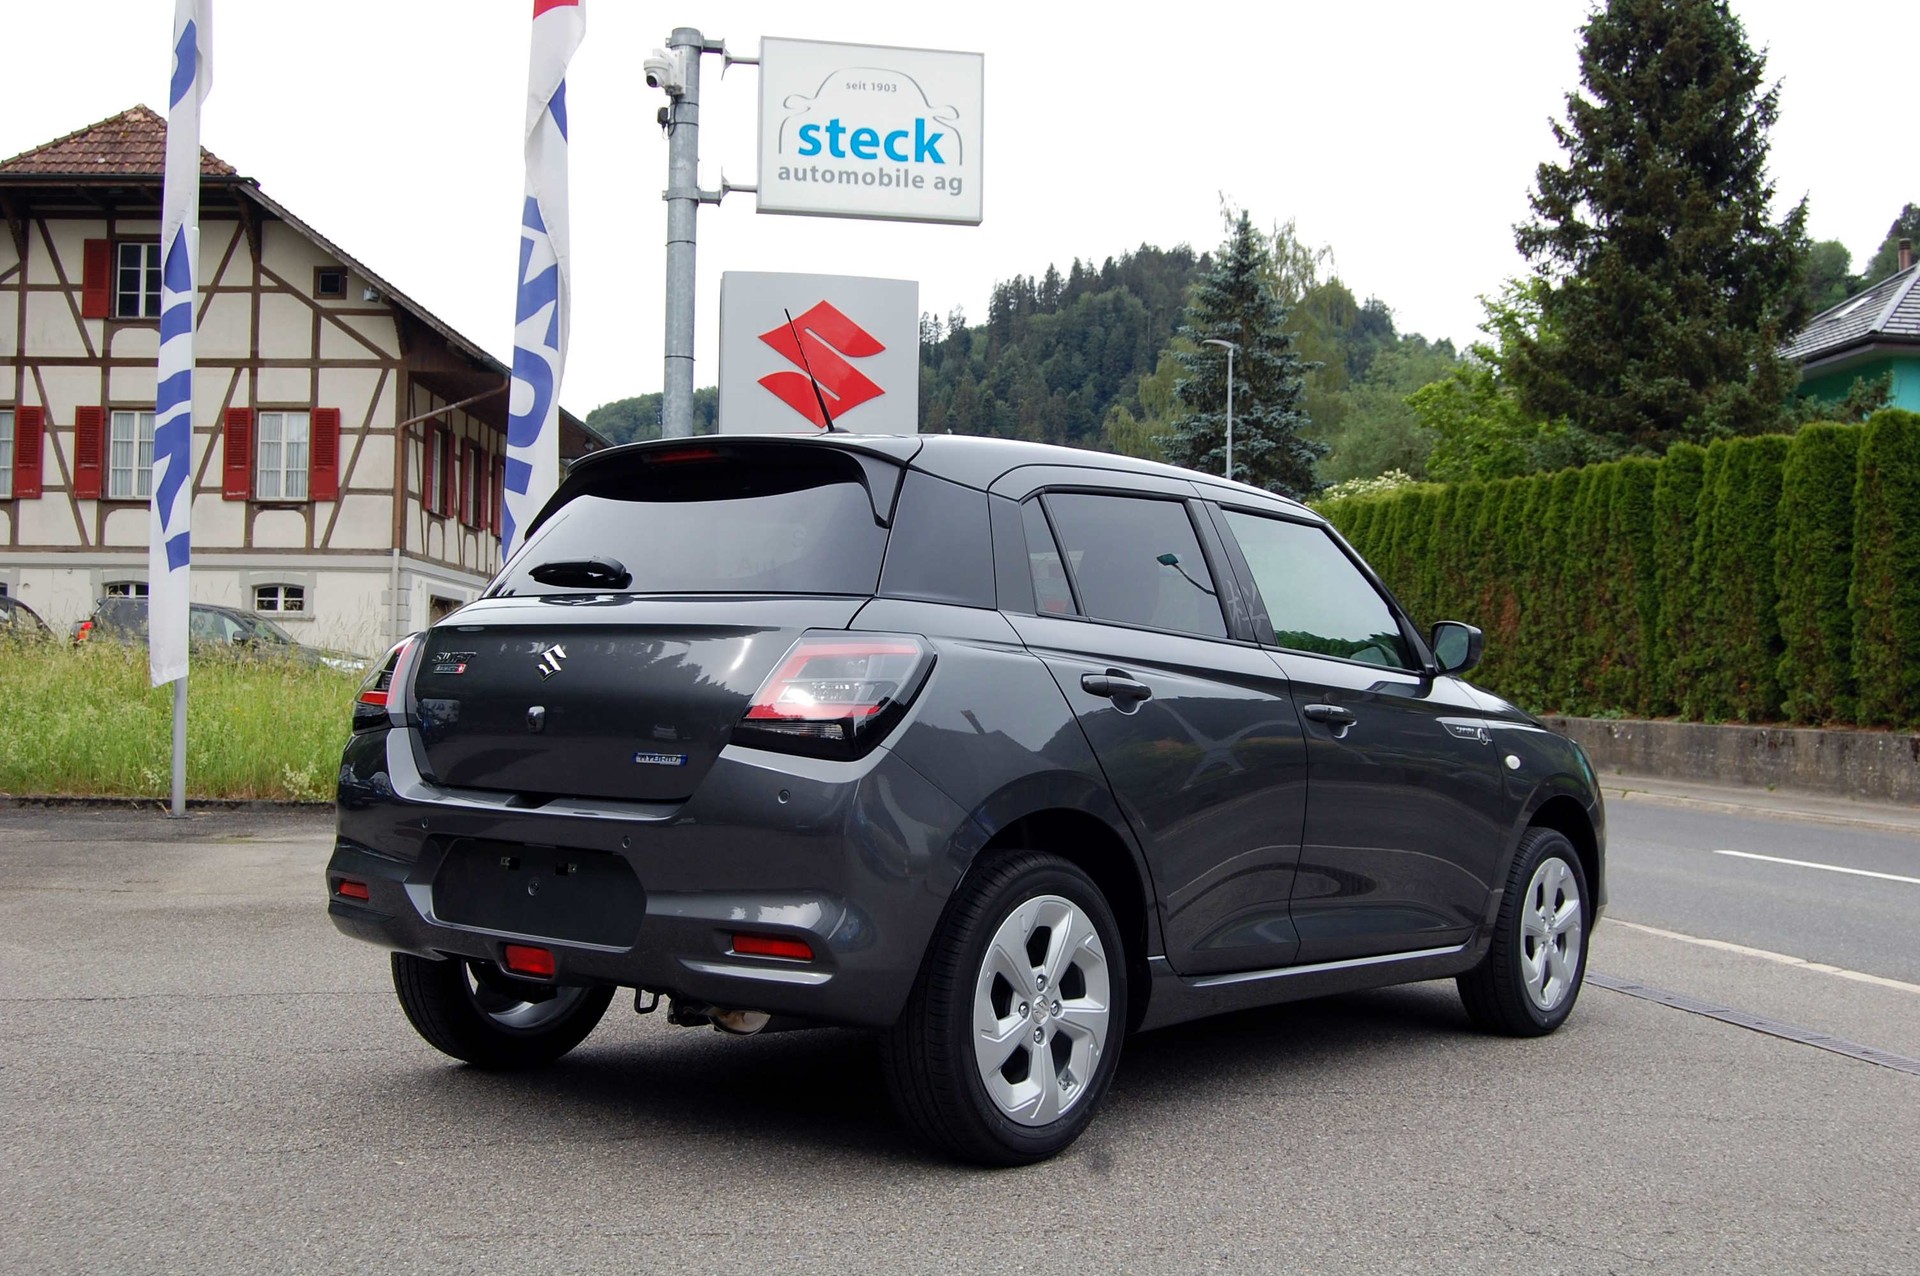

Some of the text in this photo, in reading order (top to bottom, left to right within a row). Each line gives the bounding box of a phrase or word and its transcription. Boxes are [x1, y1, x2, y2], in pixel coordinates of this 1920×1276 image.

[845, 81, 897, 93] seit 1903
[797, 117, 946, 164] steck
[777, 165, 963, 196] automobile ag
